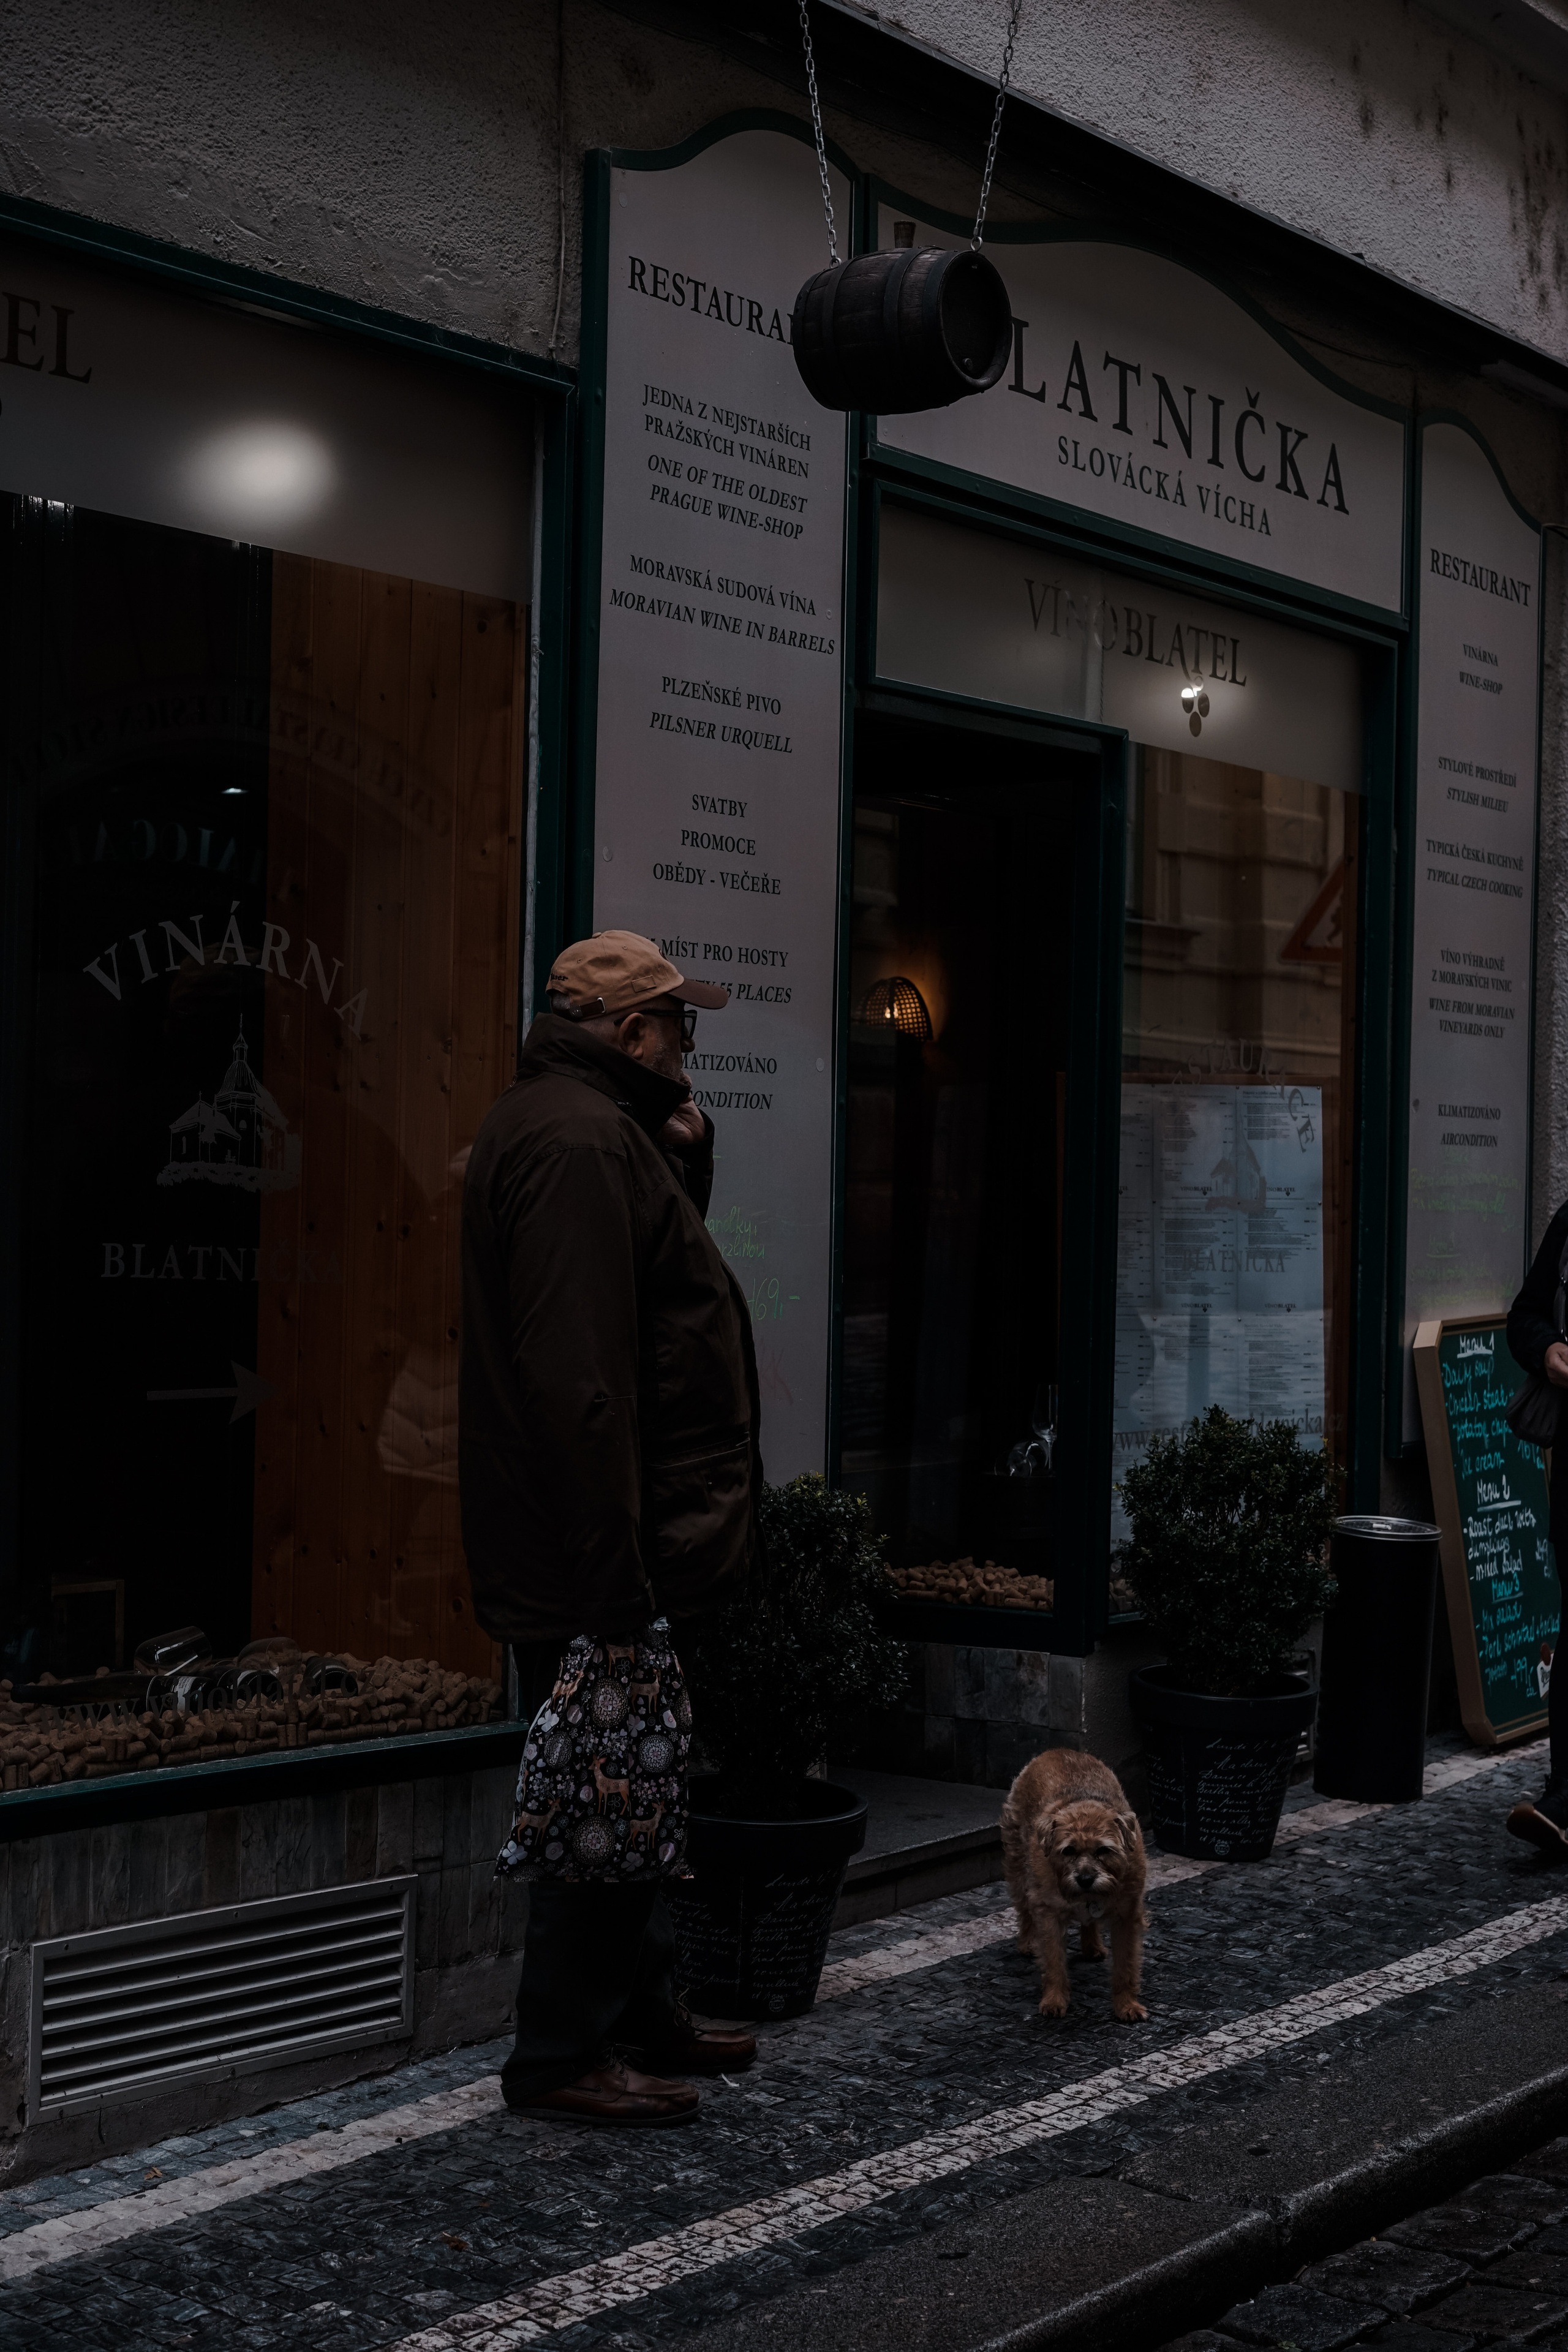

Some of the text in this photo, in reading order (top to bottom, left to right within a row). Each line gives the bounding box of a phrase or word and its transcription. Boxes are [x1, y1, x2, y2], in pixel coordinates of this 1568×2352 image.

[628, 255, 793, 345] RESTAURA
[643, 384, 812, 451] JEDNA Z NEJSTARŠÍCH
[1007, 315, 1349, 516] LATNIČKA
[645, 414, 809, 479] PRAŽSKÝCH VINÁREN
[648, 454, 808, 513] ONE OF THE OLDEST
[1057, 435, 1272, 537] SLOVÁCKÁ VÍCHA
[650, 484, 804, 540] PRAGUE WINE-SHOP
[630, 555, 816, 616] MORAVSKÁ SUDOVÁ VÍNA
[1430, 549, 1531, 607] RESTAURANT
[609, 589, 835, 655] MORAVIAN WINE IN BARRELS
[1463, 644, 1499, 667] VINÁRNA
[662, 676, 782, 715] PLZEŇSKÉ PIVO
[1459, 671, 1503, 695] WINE-SHOP
[649, 711, 793, 753] PILSNER URQUELL
[1438, 756, 1517, 788] STYLOVÉ PROSTŘEDÍ
[692, 794, 748, 818] SVATBY
[1447, 787, 1509, 813] STYLISH MILIEU
[680, 829, 756, 856] PROMOCE
[1426, 839, 1524, 872] TYPICKÁ ČESKÁ KUCHYNĚ
[653, 861, 707, 886] OBĚDY
[719, 870, 782, 895] VEČEŘE
[1427, 868, 1523, 899] TYPICAL CZECH COOKING
[662, 936, 789, 968] MÍST PRO HOSTY
[1441, 947, 1506, 972] VÍNO VÝHRADNĚ
[83, 900, 369, 1040] VINÁRNA
[1431, 969, 1512, 993] Z MORAVSKÝCH VINIC
[736, 983, 792, 1004] PLACES
[1429, 997, 1515, 1020] WINE FROM MORAVIAN
[1439, 1019, 1506, 1039] VINEYARDS ONLY
[682, 1052, 777, 1074] MATIZOVÁNO
[690, 1090, 773, 1110] ONDITION
[1438, 1102, 1501, 1120] KLIMATIZOVÁNO
[1440, 1132, 1499, 1148] AIRCONDITION
[100, 1240, 344, 1284] BLATNIČKA
[1181, 1245, 1286, 1273] BLATNIČKA
[1459, 1330, 1495, 1354] Menu 1
[1477, 1474, 1510, 1505] Menu 2
[40, 1665, 376, 1738] www.vinoblatel.cz
